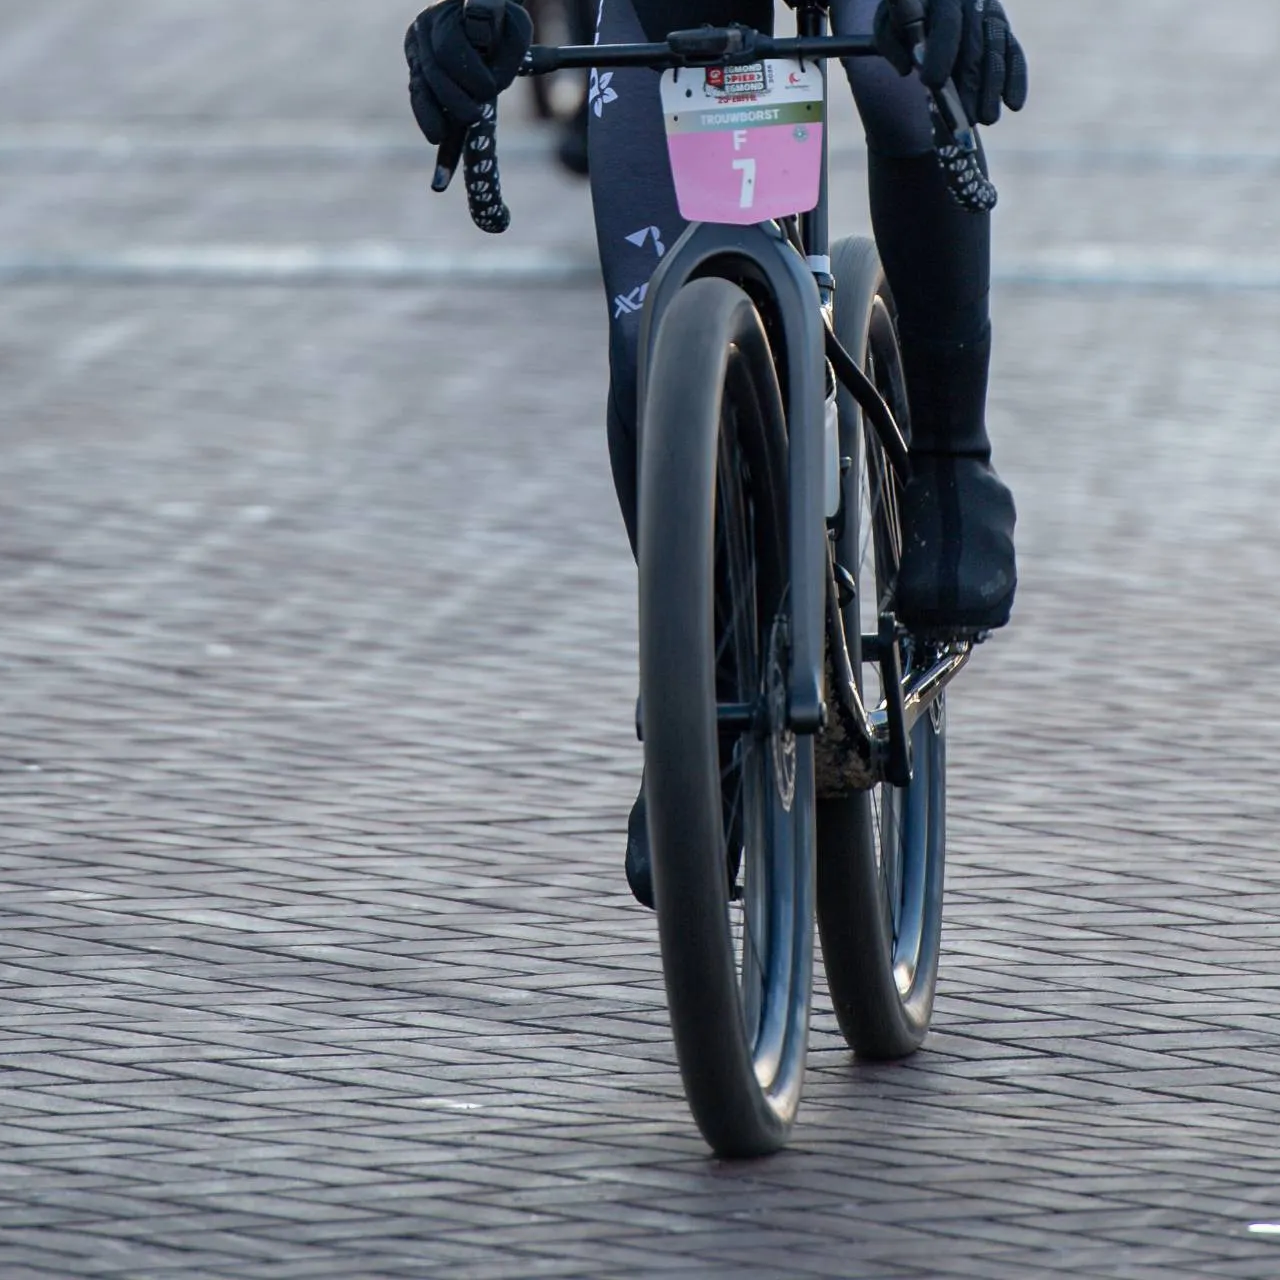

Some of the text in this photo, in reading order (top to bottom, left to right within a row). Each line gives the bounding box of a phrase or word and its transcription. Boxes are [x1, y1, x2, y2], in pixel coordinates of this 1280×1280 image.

[701, 108, 781, 126] TROUWBORST
[732, 130, 748, 151] F
[732, 158, 757, 209] 7
